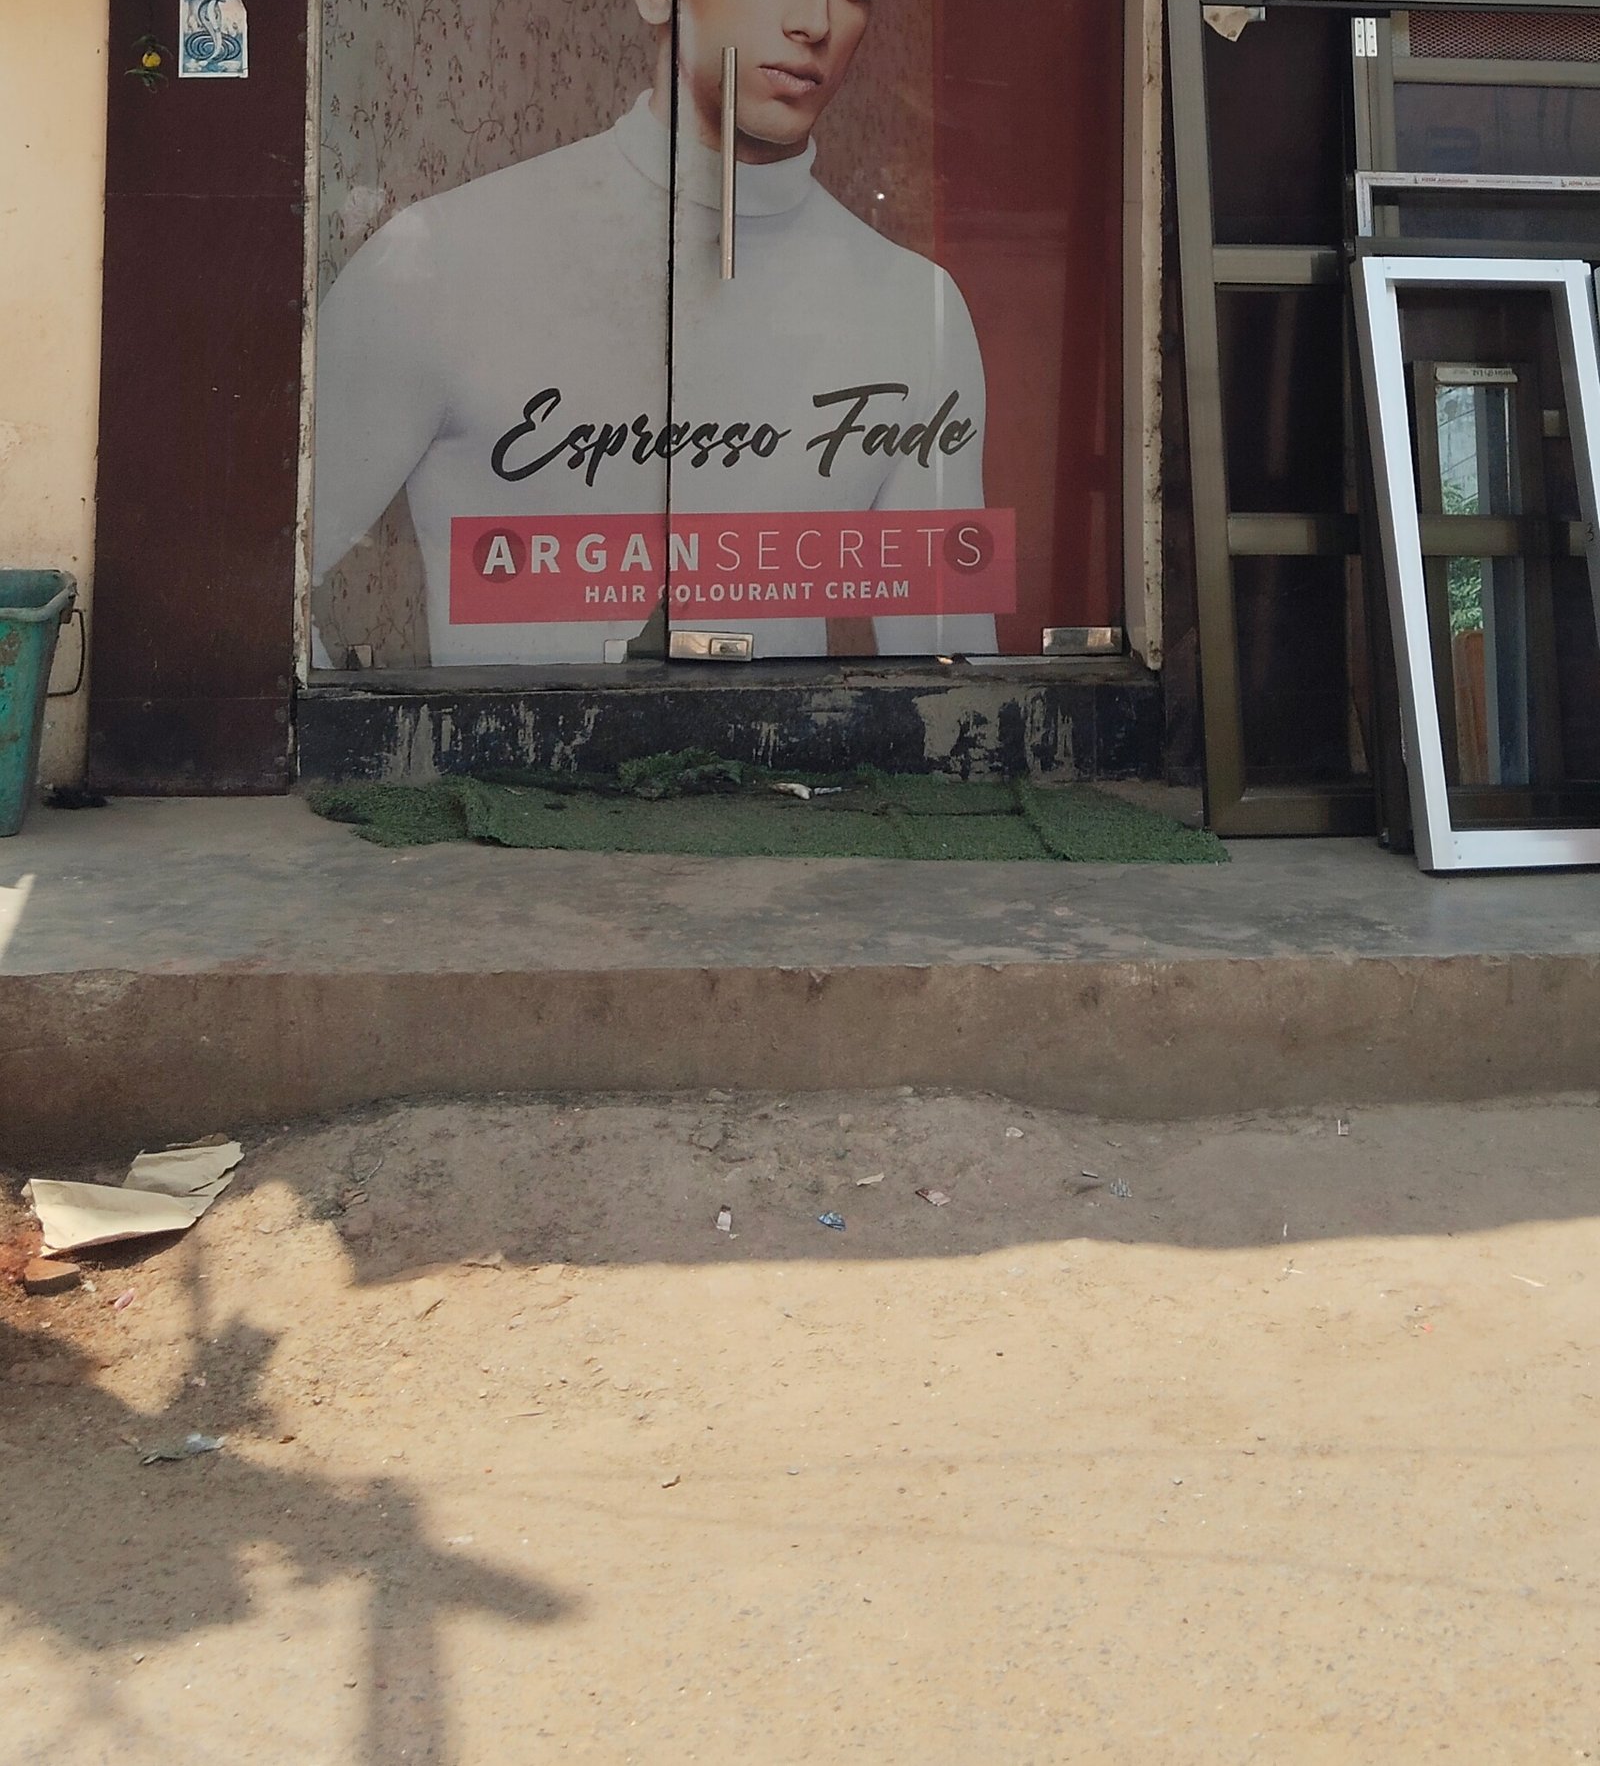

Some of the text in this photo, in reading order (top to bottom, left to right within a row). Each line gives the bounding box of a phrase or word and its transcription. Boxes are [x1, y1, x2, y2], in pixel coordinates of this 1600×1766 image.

[490, 382, 977, 487] Espresso Fade
[584, 580, 910, 604] HAIR COLOURANT CREAM
